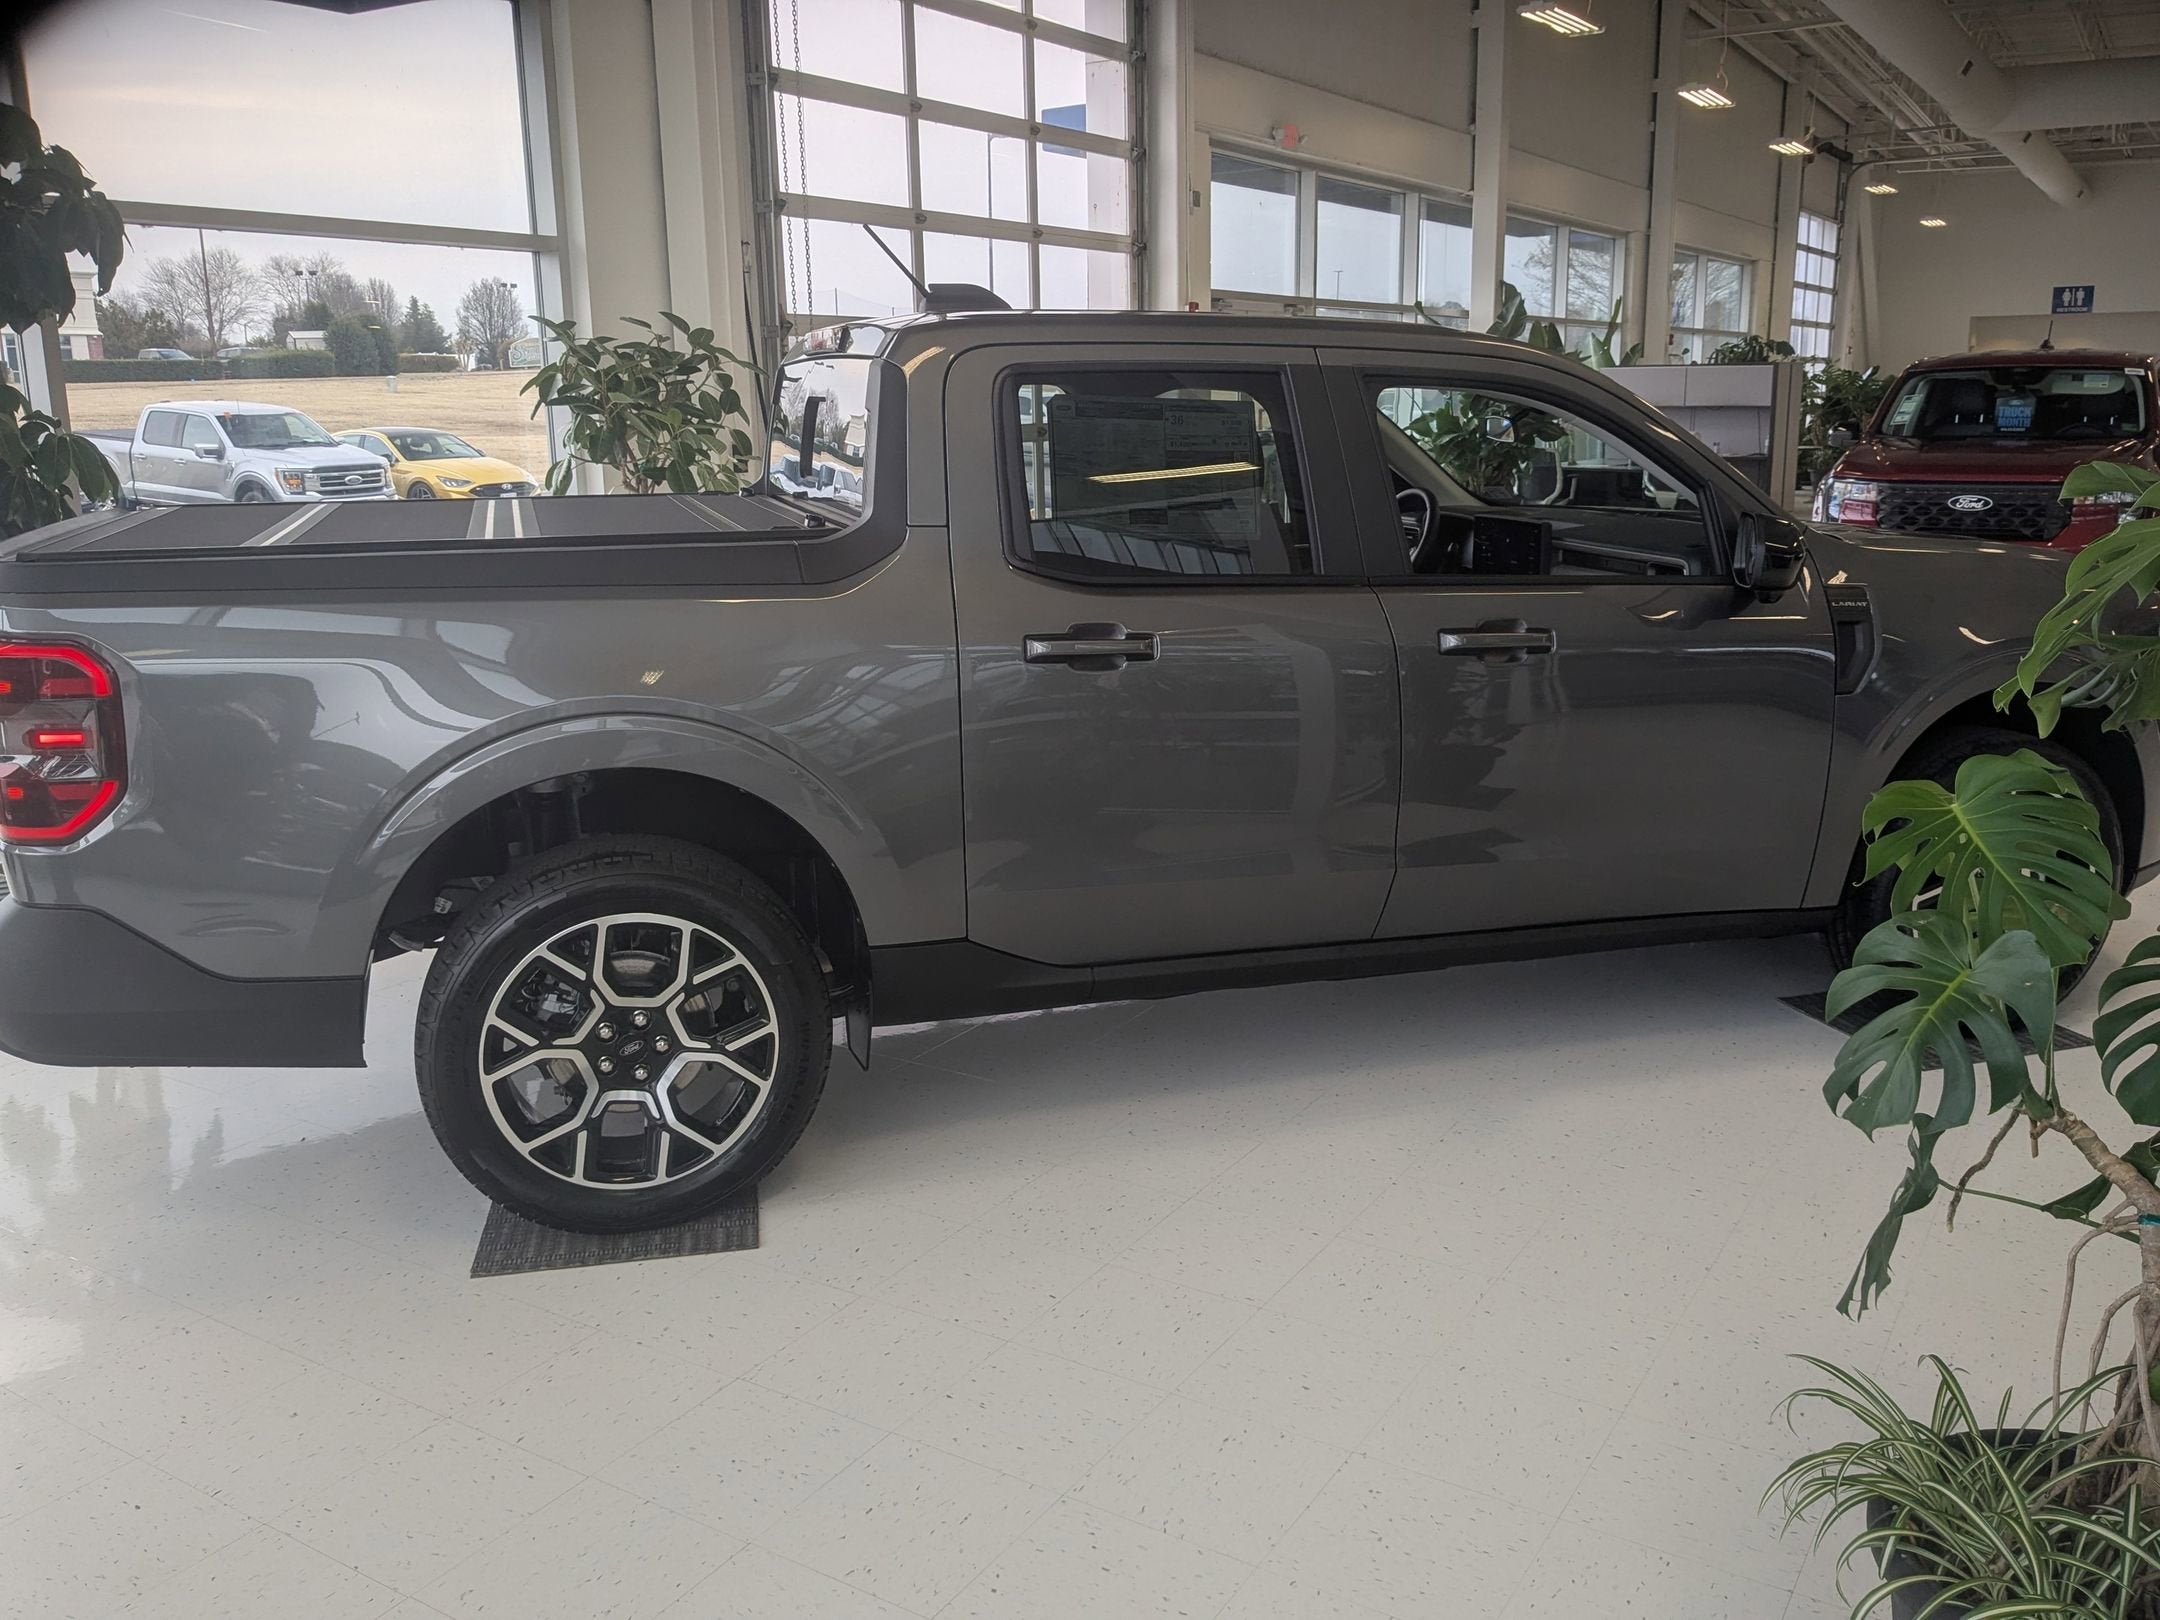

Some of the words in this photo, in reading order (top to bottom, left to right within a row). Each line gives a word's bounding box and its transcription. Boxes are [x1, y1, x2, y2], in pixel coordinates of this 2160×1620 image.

[1999, 406, 2032, 417] TRUCK
[1998, 417, 2031, 428] MONTH
[1955, 497, 1985, 509] Ford
